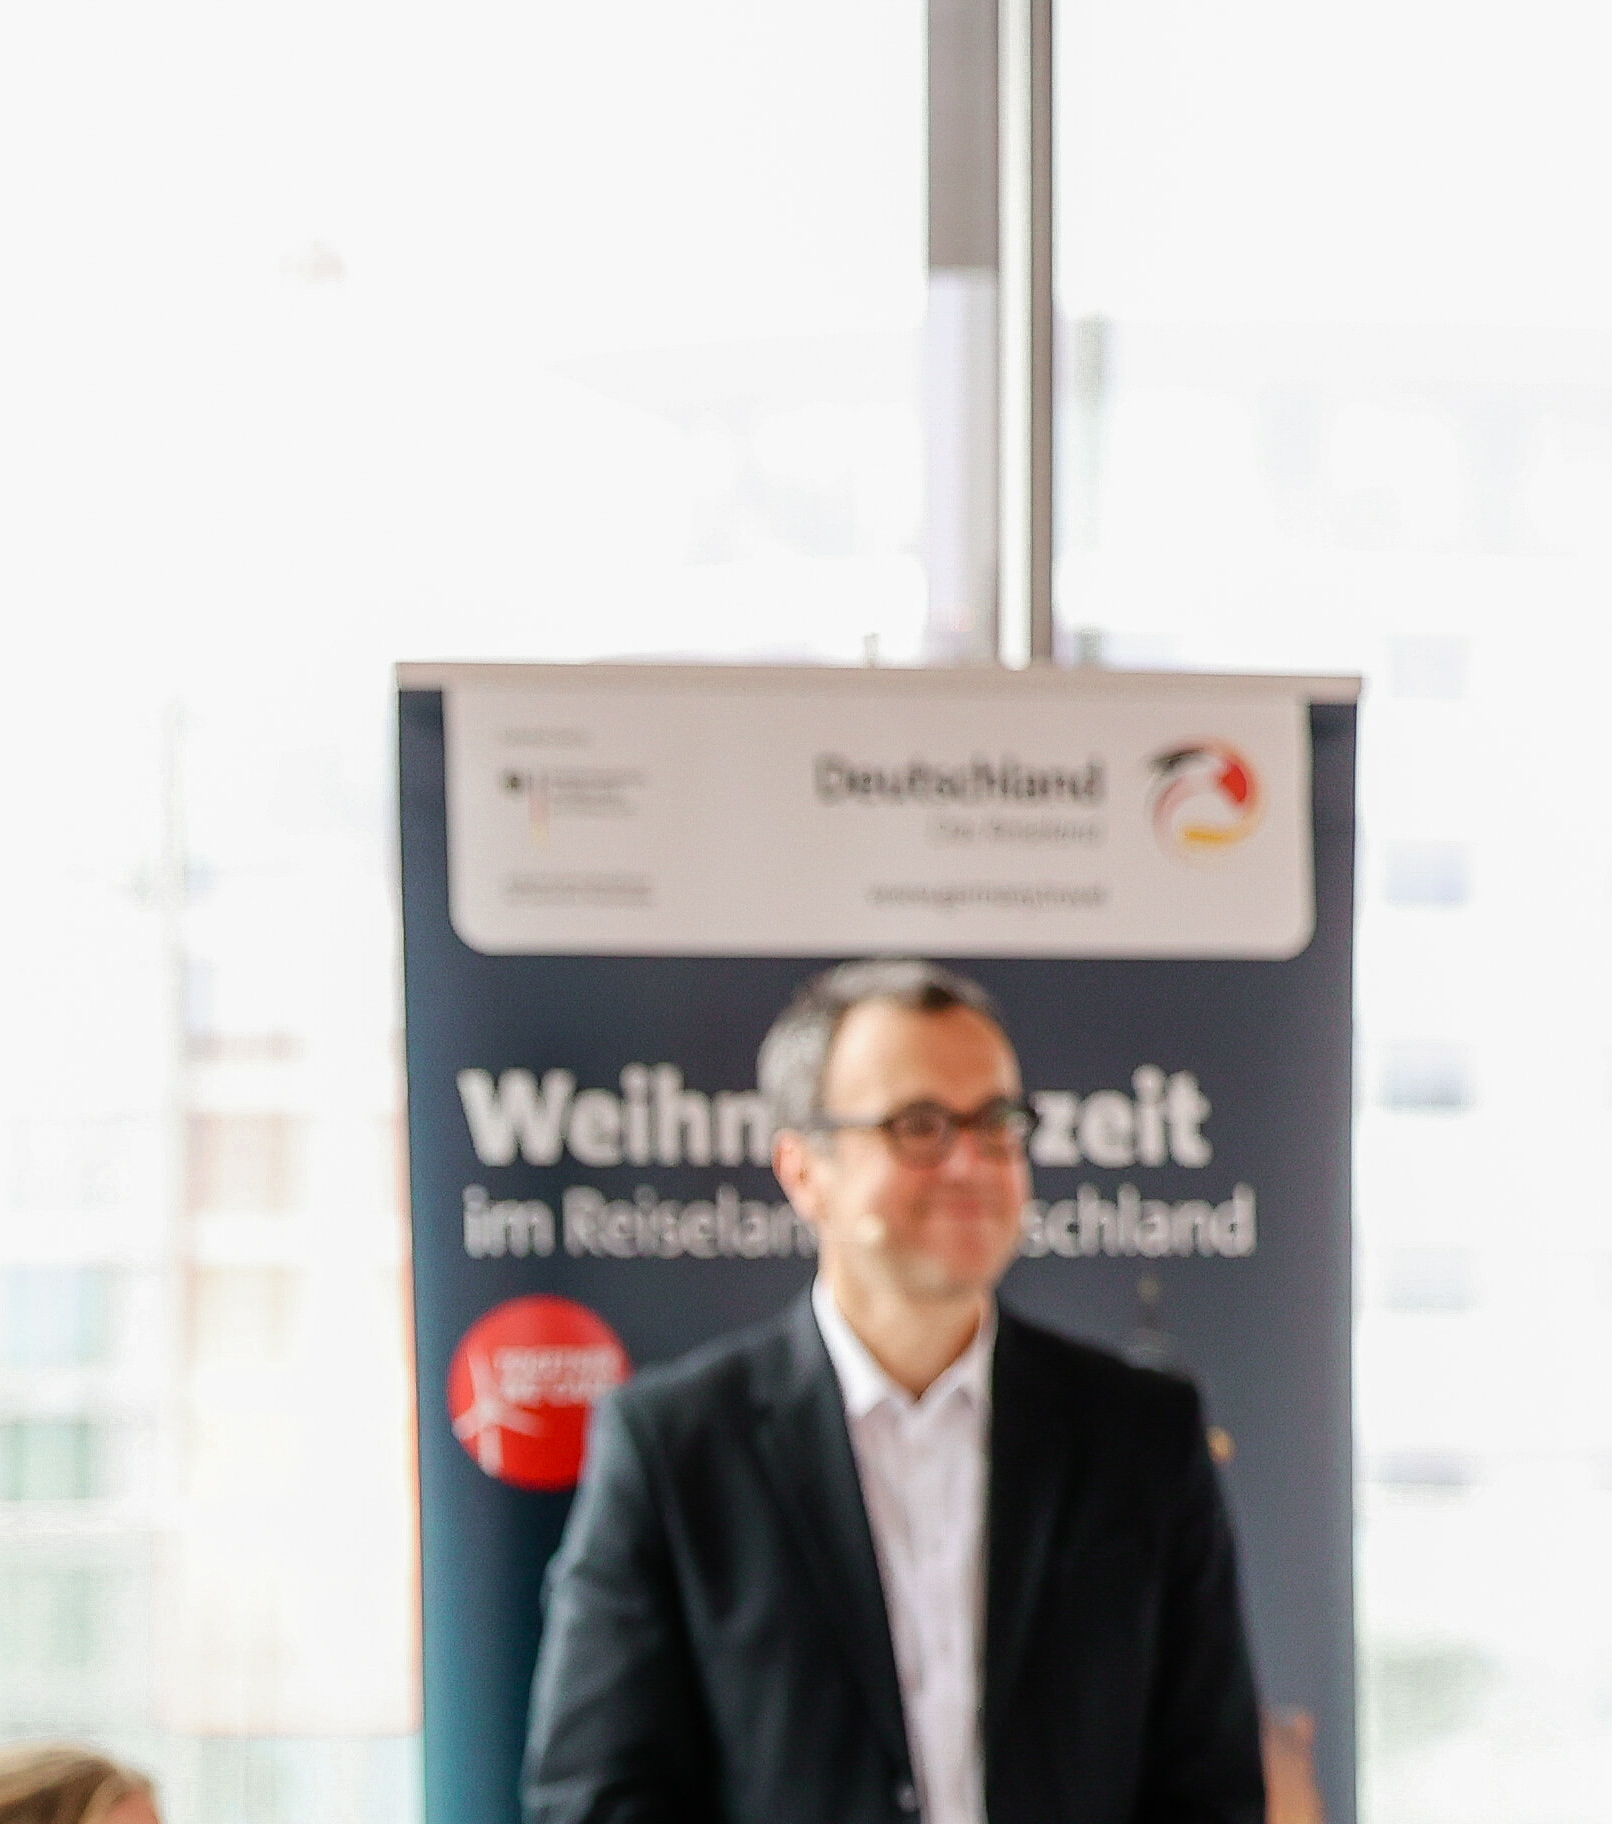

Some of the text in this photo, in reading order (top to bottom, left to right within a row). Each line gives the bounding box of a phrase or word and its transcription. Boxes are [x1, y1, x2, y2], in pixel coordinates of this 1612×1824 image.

[813, 752, 1105, 804] Deutschland
[462, 1182, 1258, 1258] im Reiselan schland
